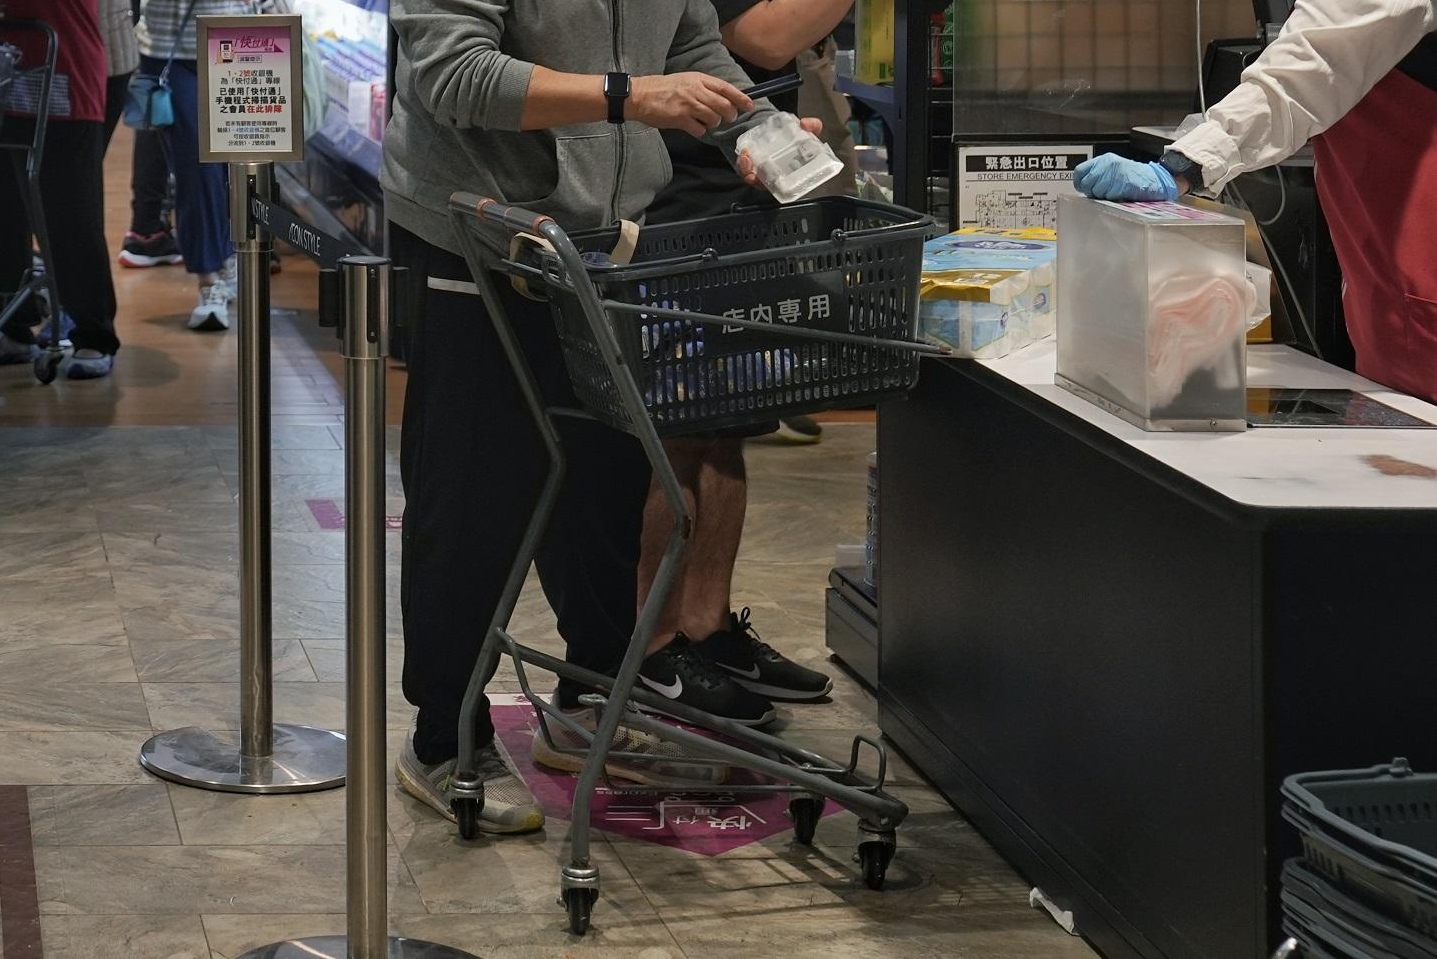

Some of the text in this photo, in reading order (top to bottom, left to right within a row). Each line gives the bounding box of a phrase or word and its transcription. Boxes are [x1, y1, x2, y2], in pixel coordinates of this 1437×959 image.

[219, 87, 282, 96] 已使用「快付通」
[220, 105, 283, 114] 之會員在此排隊
[985, 155, 1069, 170] 緊急出口位置
[1060, 172, 1076, 180] EXI
[303, 229, 321, 258] STYLE
